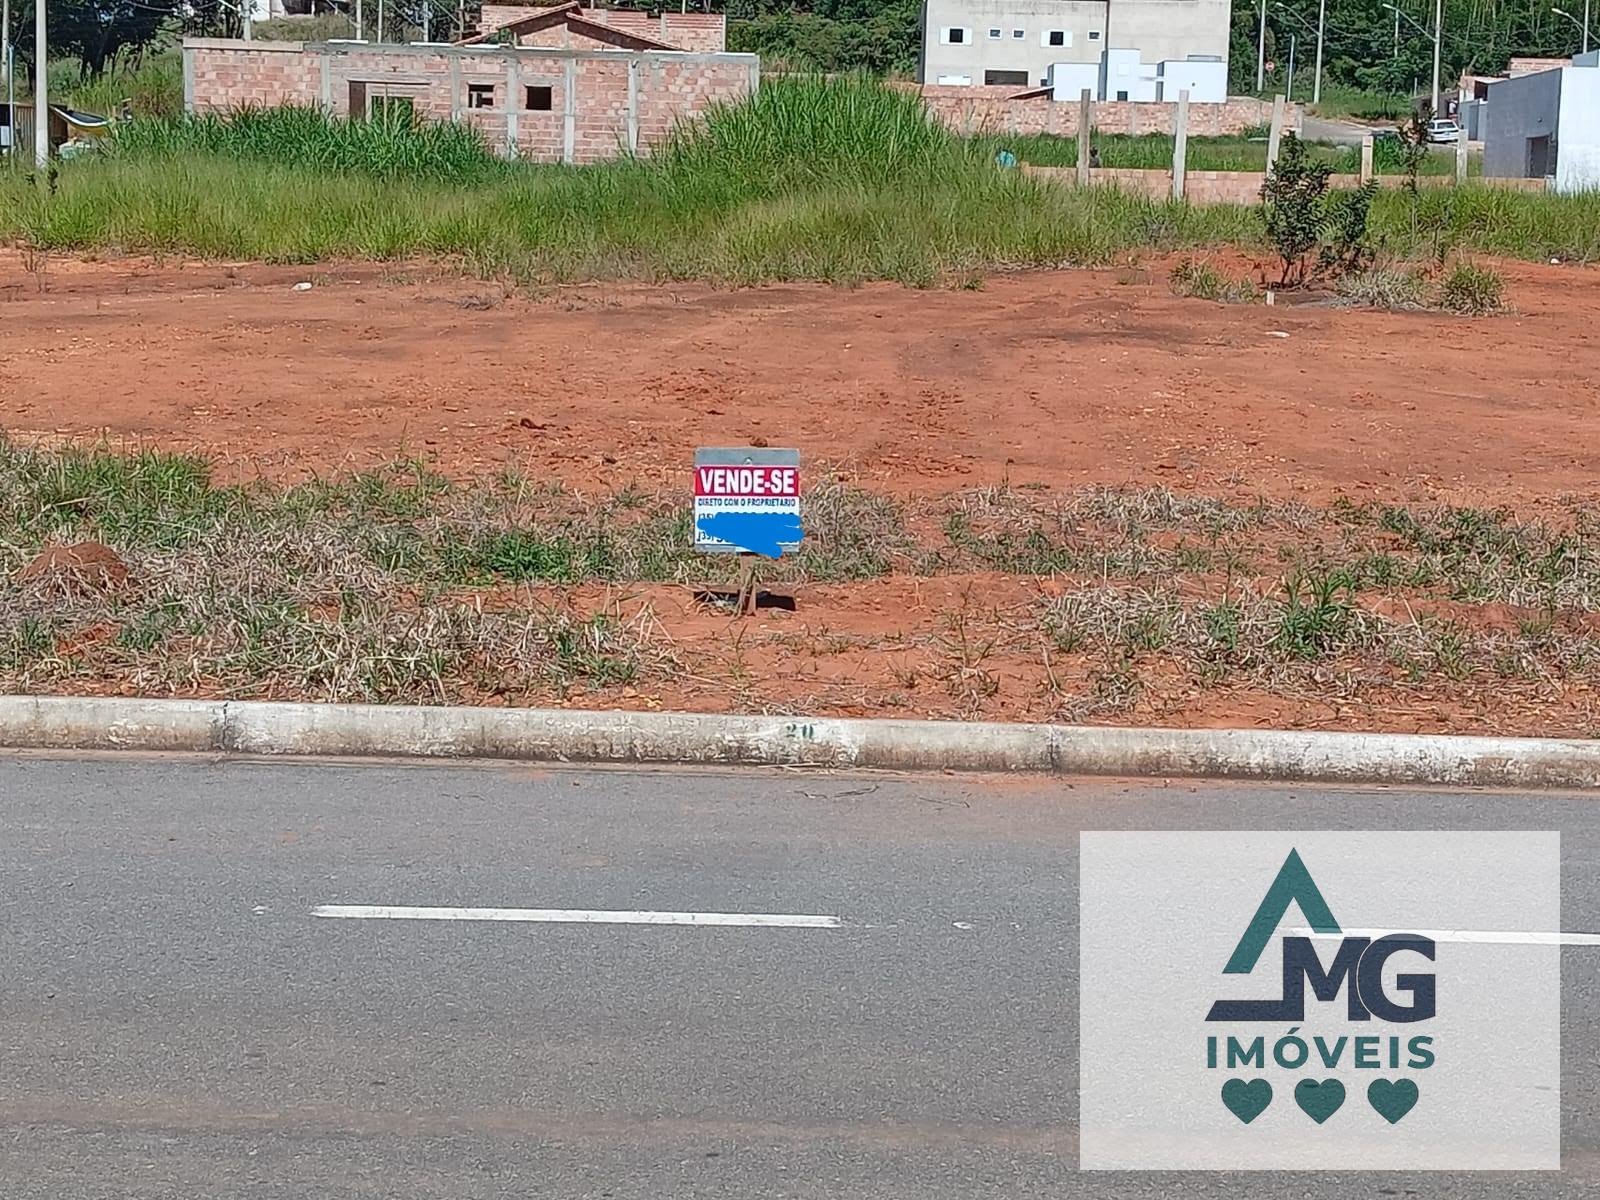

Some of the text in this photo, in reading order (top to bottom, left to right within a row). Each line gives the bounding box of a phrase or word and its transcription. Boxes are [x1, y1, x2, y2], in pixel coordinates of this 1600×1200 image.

[700, 468, 795, 494] VENDE-SE
[698, 498, 722, 507] DIRETO
[724, 498, 739, 507] COM
[741, 498, 746, 507] O
